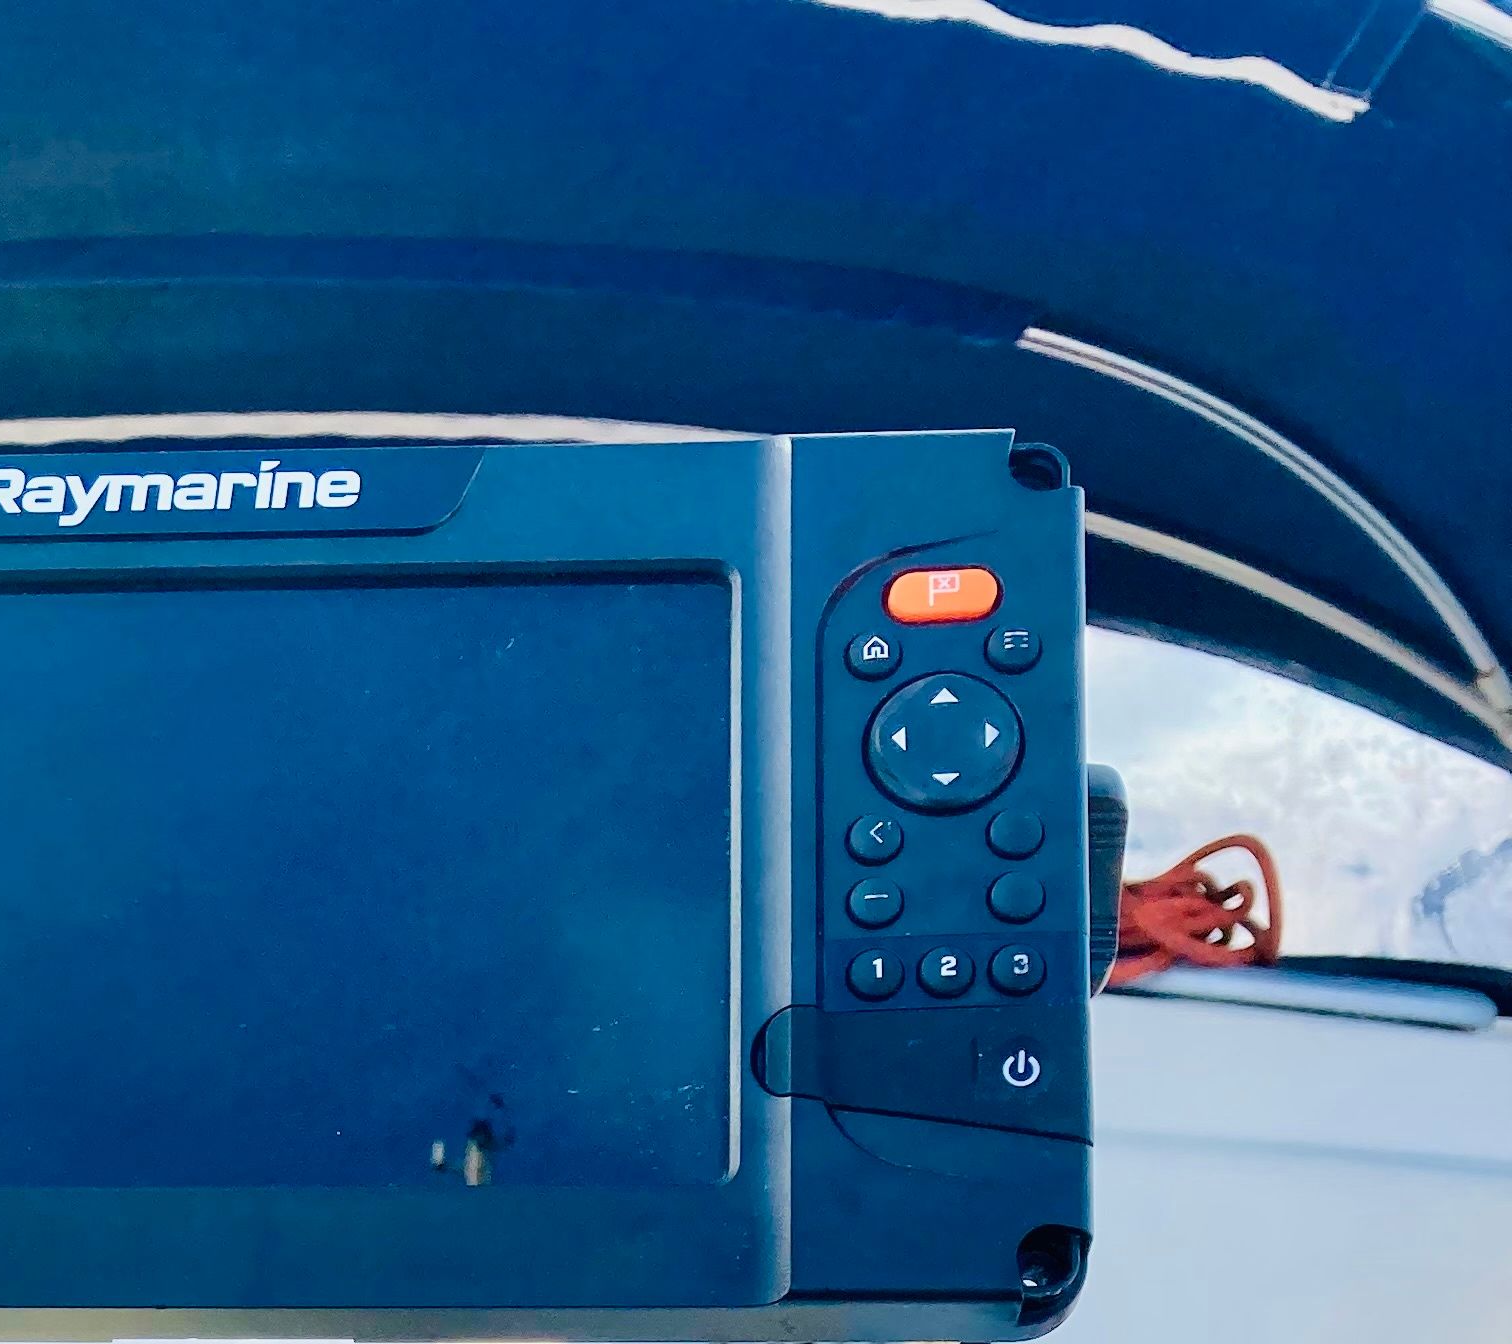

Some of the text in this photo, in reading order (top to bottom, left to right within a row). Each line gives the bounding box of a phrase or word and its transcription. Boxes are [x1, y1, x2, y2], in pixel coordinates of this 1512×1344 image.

[872, 953, 1030, 978] 1 2 3
